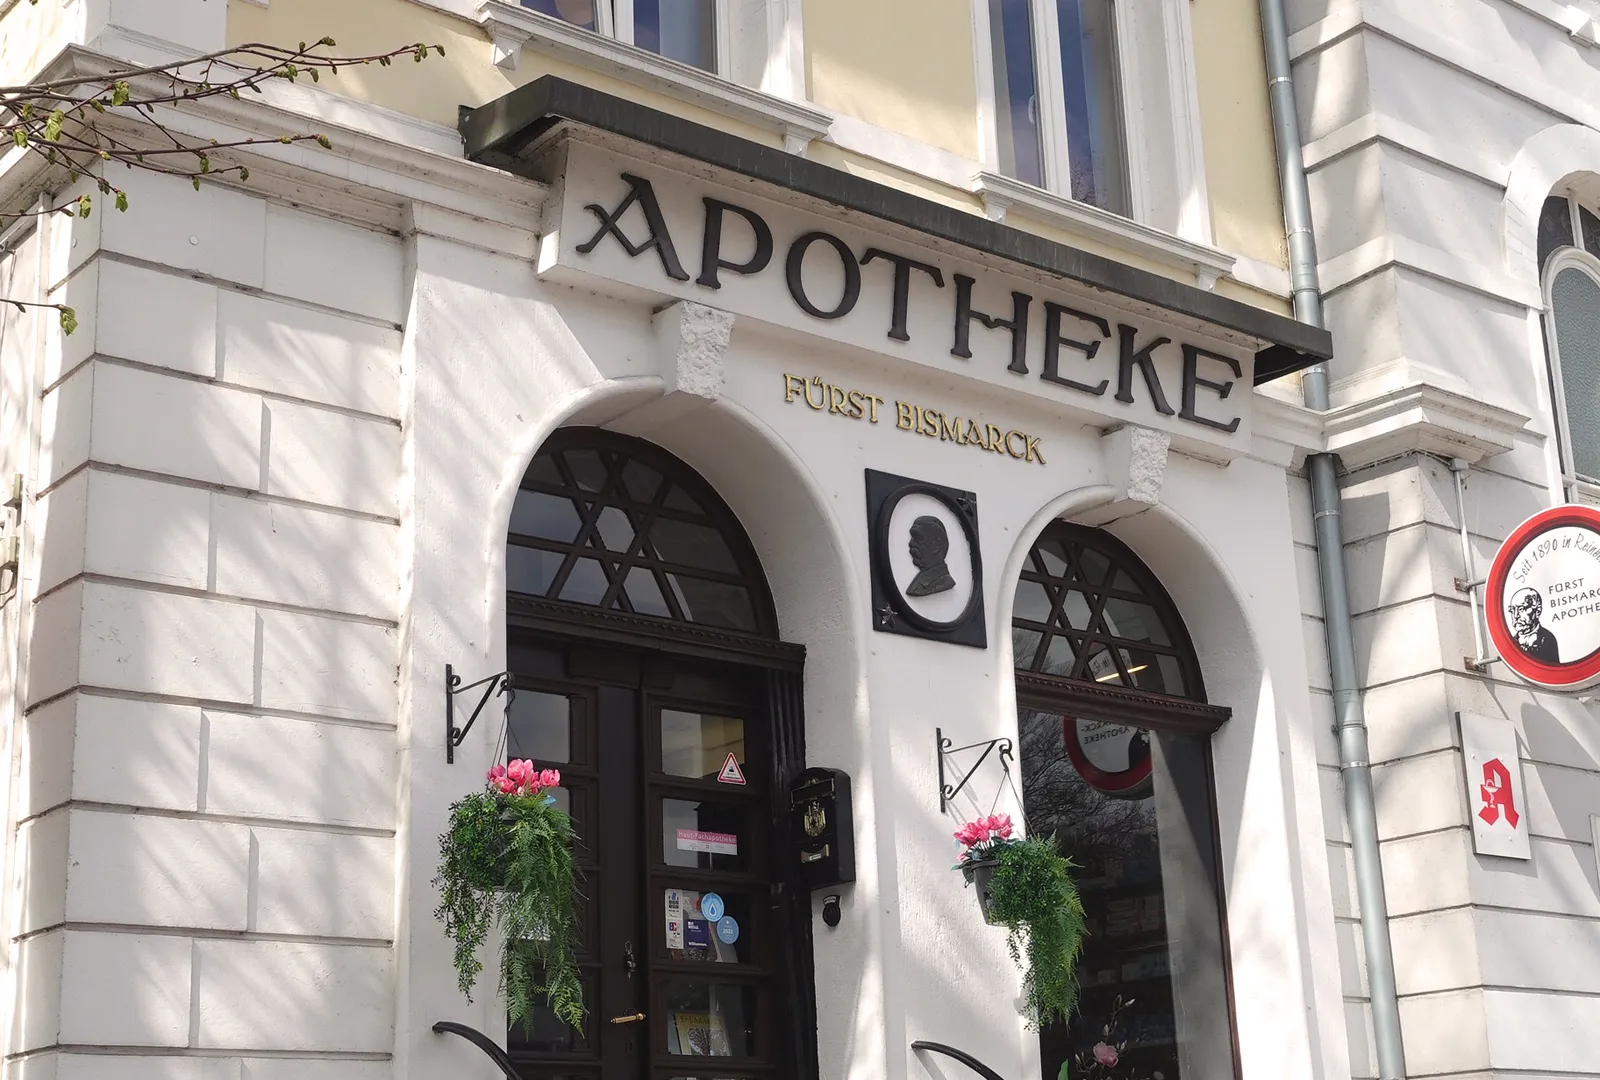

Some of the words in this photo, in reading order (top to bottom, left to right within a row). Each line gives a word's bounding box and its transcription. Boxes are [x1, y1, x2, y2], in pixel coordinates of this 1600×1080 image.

[575, 172, 1242, 434] APOTHEKE
[783, 372, 884, 424] FÜRST
[895, 399, 1047, 466] BISMARCK
[1512, 558, 1533, 584] Seit
[1532, 538, 1558, 562] 1890
[1562, 535, 1572, 549] in
[1548, 577, 1585, 595] FÜRST
[678, 830, 736, 844] Haut-Fachapotheke
